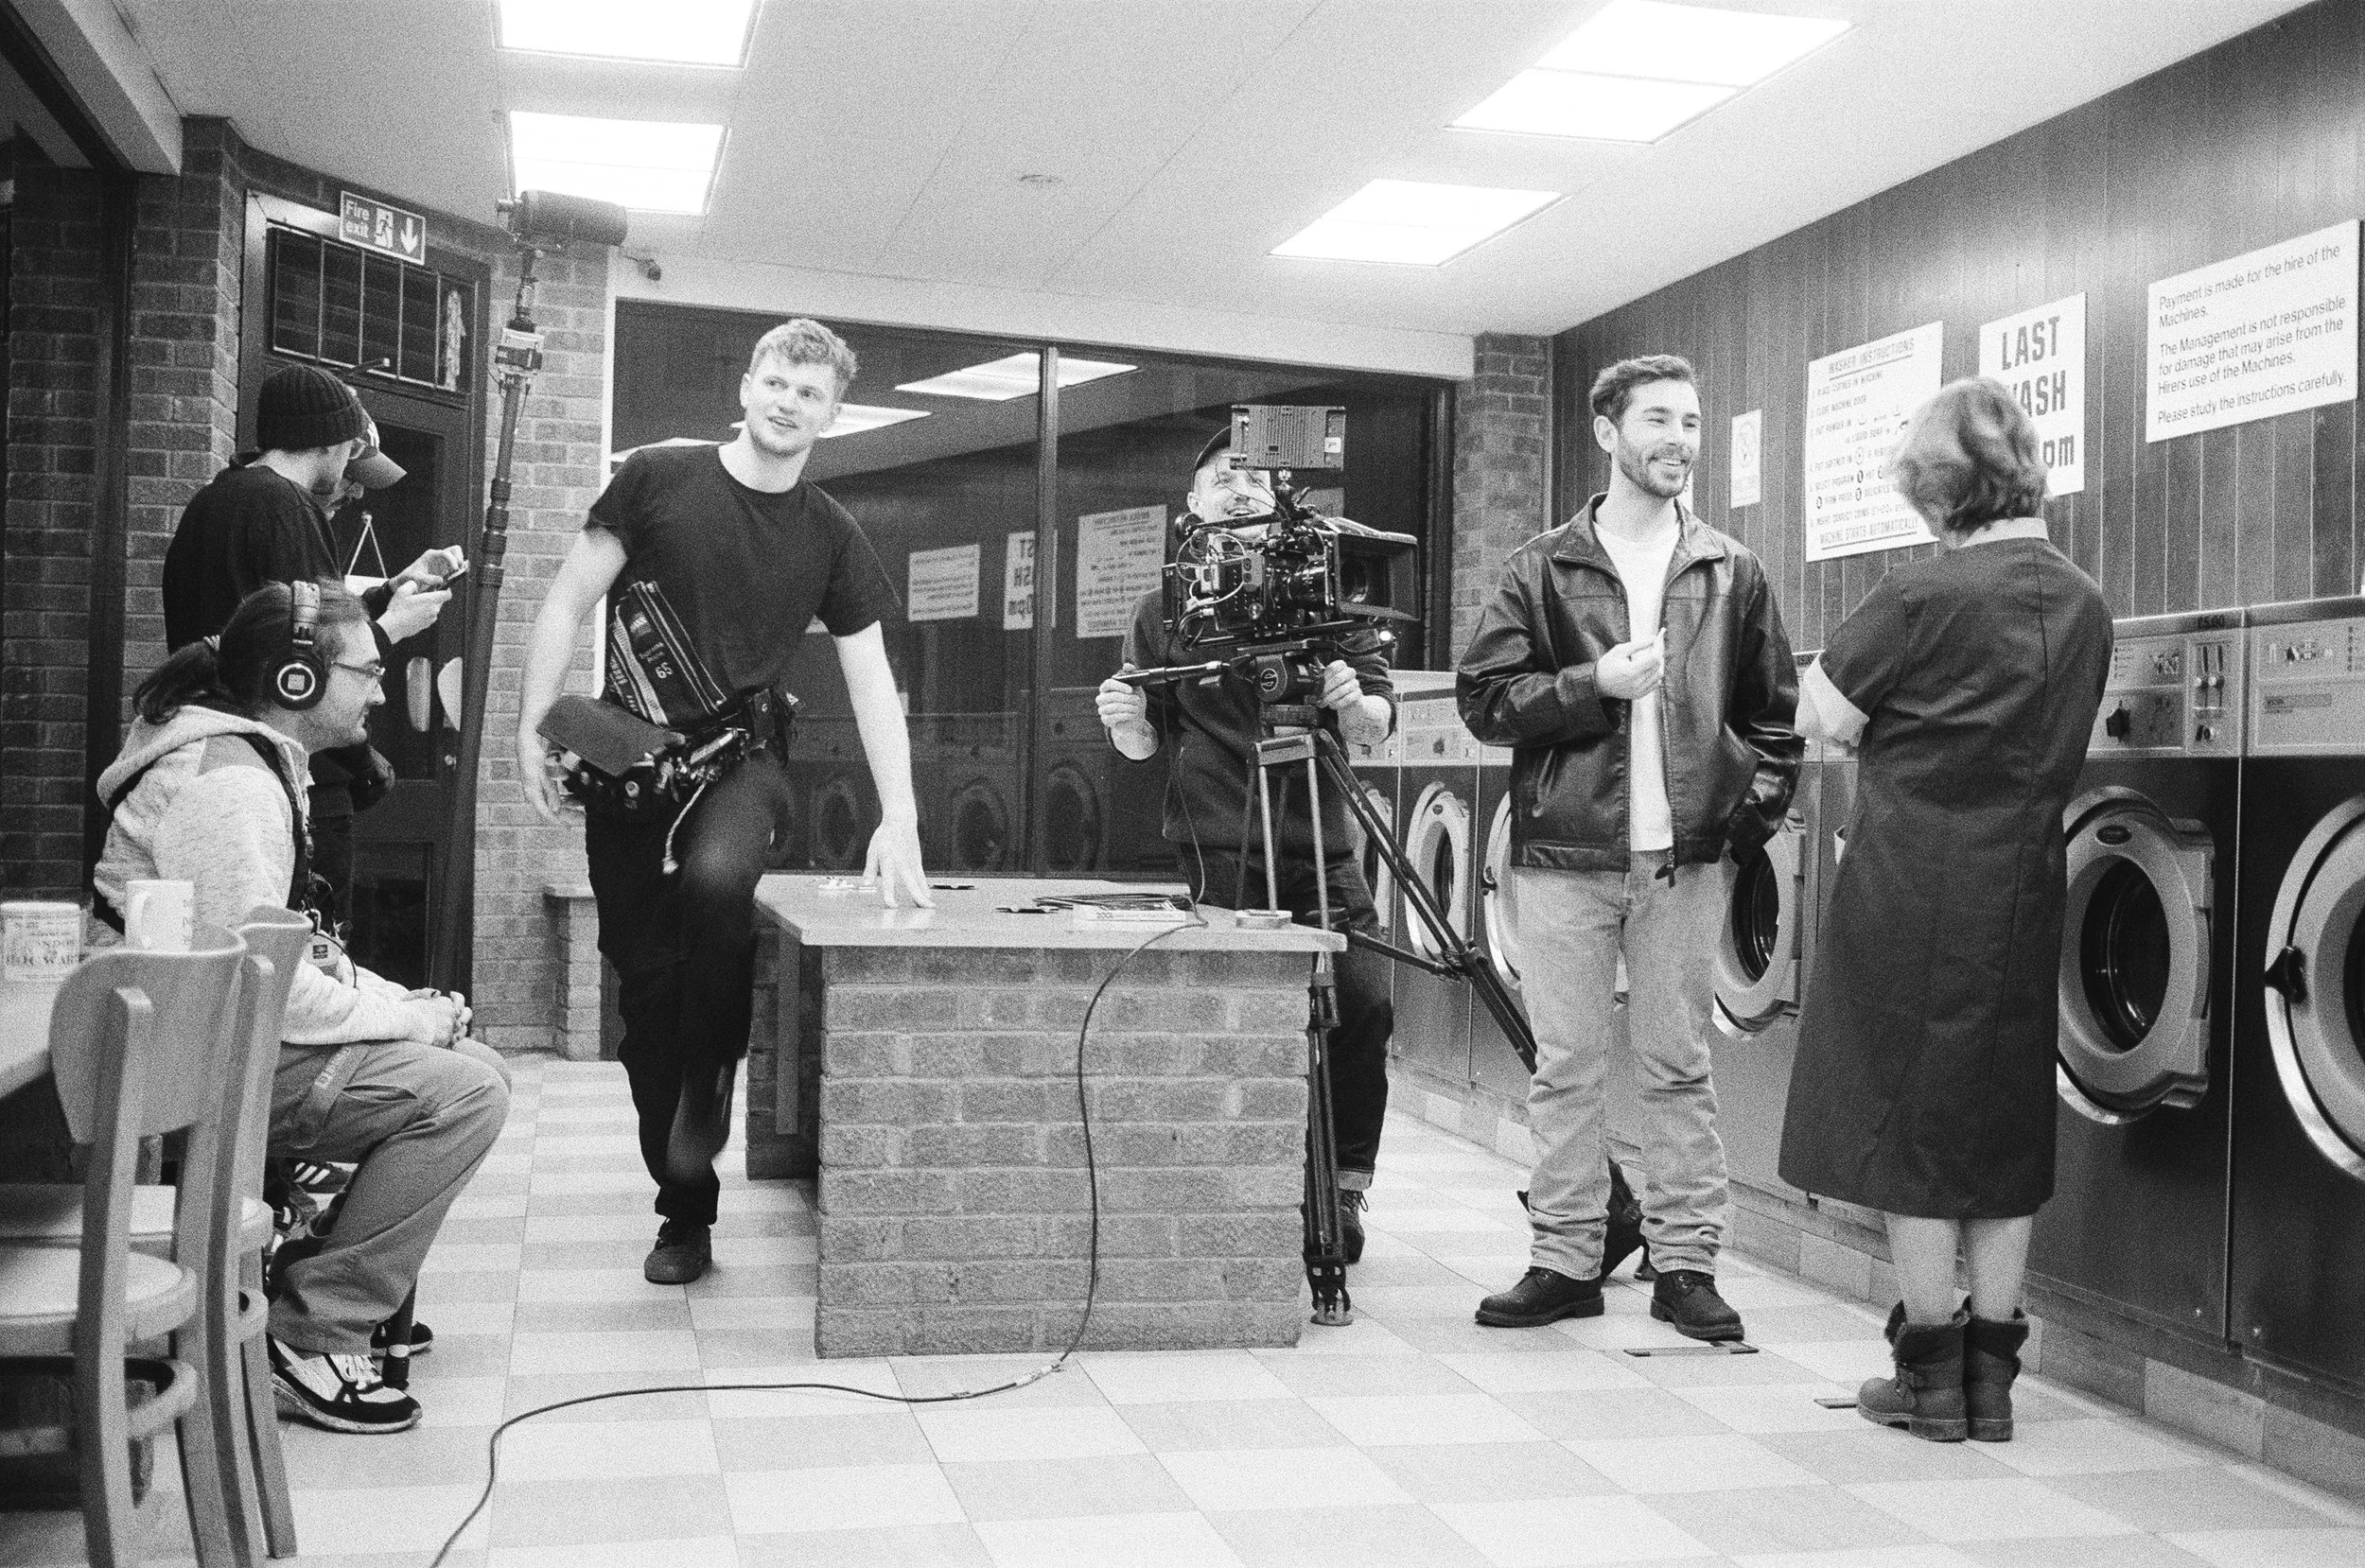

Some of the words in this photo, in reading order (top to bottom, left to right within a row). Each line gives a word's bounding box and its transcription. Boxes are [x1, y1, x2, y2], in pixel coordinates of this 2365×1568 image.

[345, 200, 370, 221] Fire
[345, 221, 369, 238] exit
[2160, 287, 2202, 311] Payment
[2204, 284, 2213, 295] is
[2215, 274, 2244, 293] made
[2247, 270, 2262, 284] for
[2265, 264, 2282, 278] the
[2285, 256, 2304, 272] hire
[2307, 249, 2319, 266] of
[2321, 244, 2340, 261] the
[2160, 306, 2208, 328] Machines.
[2161, 340, 2177, 357] The
[2180, 324, 2246, 353] Management
[2248, 322, 2257, 333] is
[2260, 315, 2277, 331] not
[2279, 295, 2346, 326] responsible
[2002, 315, 2060, 371] LAST
[2160, 363, 2173, 375] for
[2175, 353, 2216, 373] damage
[2218, 345, 2238, 359] that
[2241, 339, 2262, 355] may
[2266, 331, 2293, 348] arise
[2296, 324, 2321, 340] from
[2324, 318, 2343, 333] the
[2013, 370, 2066, 418] ASH
[2158, 377, 2186, 394] Hirers
[2189, 375, 2208, 387] use
[2210, 371, 2221, 383] of
[2223, 366, 2240, 379] the
[2242, 353, 2296, 375] Machines.
[2158, 408, 2188, 424] Please
[2190, 401, 2216, 417] study
[2219, 396, 2234, 410] the
[2236, 383, 2296, 407] instructions
[2298, 371, 2347, 392] carefully.
